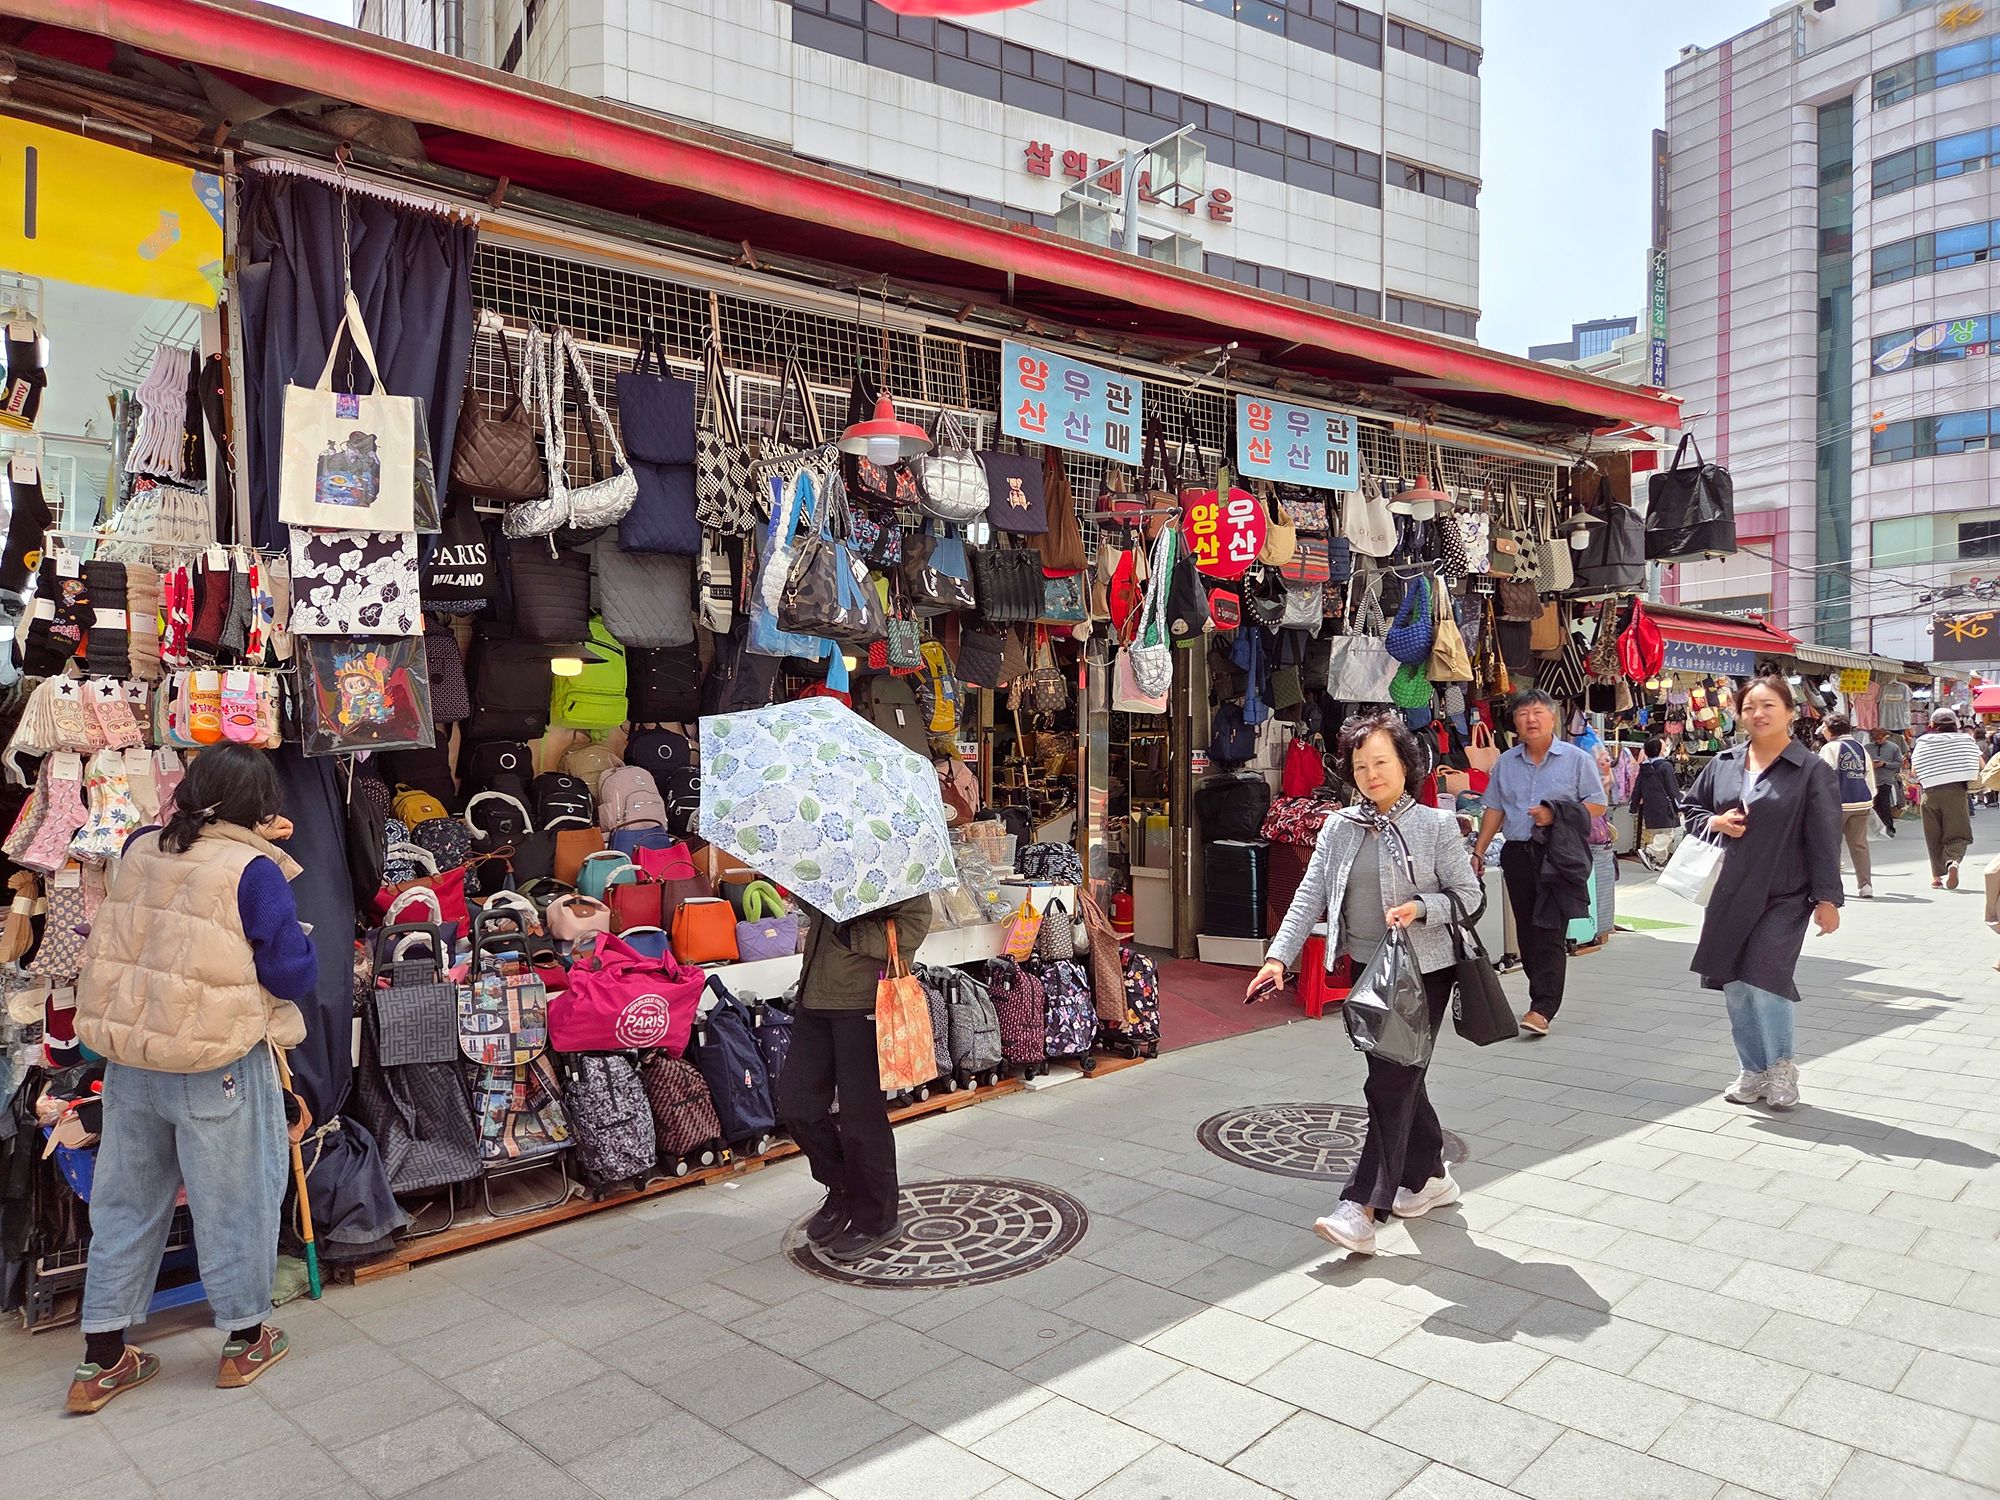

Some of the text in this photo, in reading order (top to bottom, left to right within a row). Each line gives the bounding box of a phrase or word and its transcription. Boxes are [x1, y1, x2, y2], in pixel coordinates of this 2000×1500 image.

[1655, 264, 1665, 322] 상은안경
[8, 382, 29, 412] funny
[1016, 355, 1133, 455] 양산 우산 판매
[1247, 402, 1350, 476] 양산 우산 판매
[1191, 499, 1256, 565] 양산 우산
[431, 572, 484, 587] MILANO
[623, 1014, 665, 1029] PARIS
